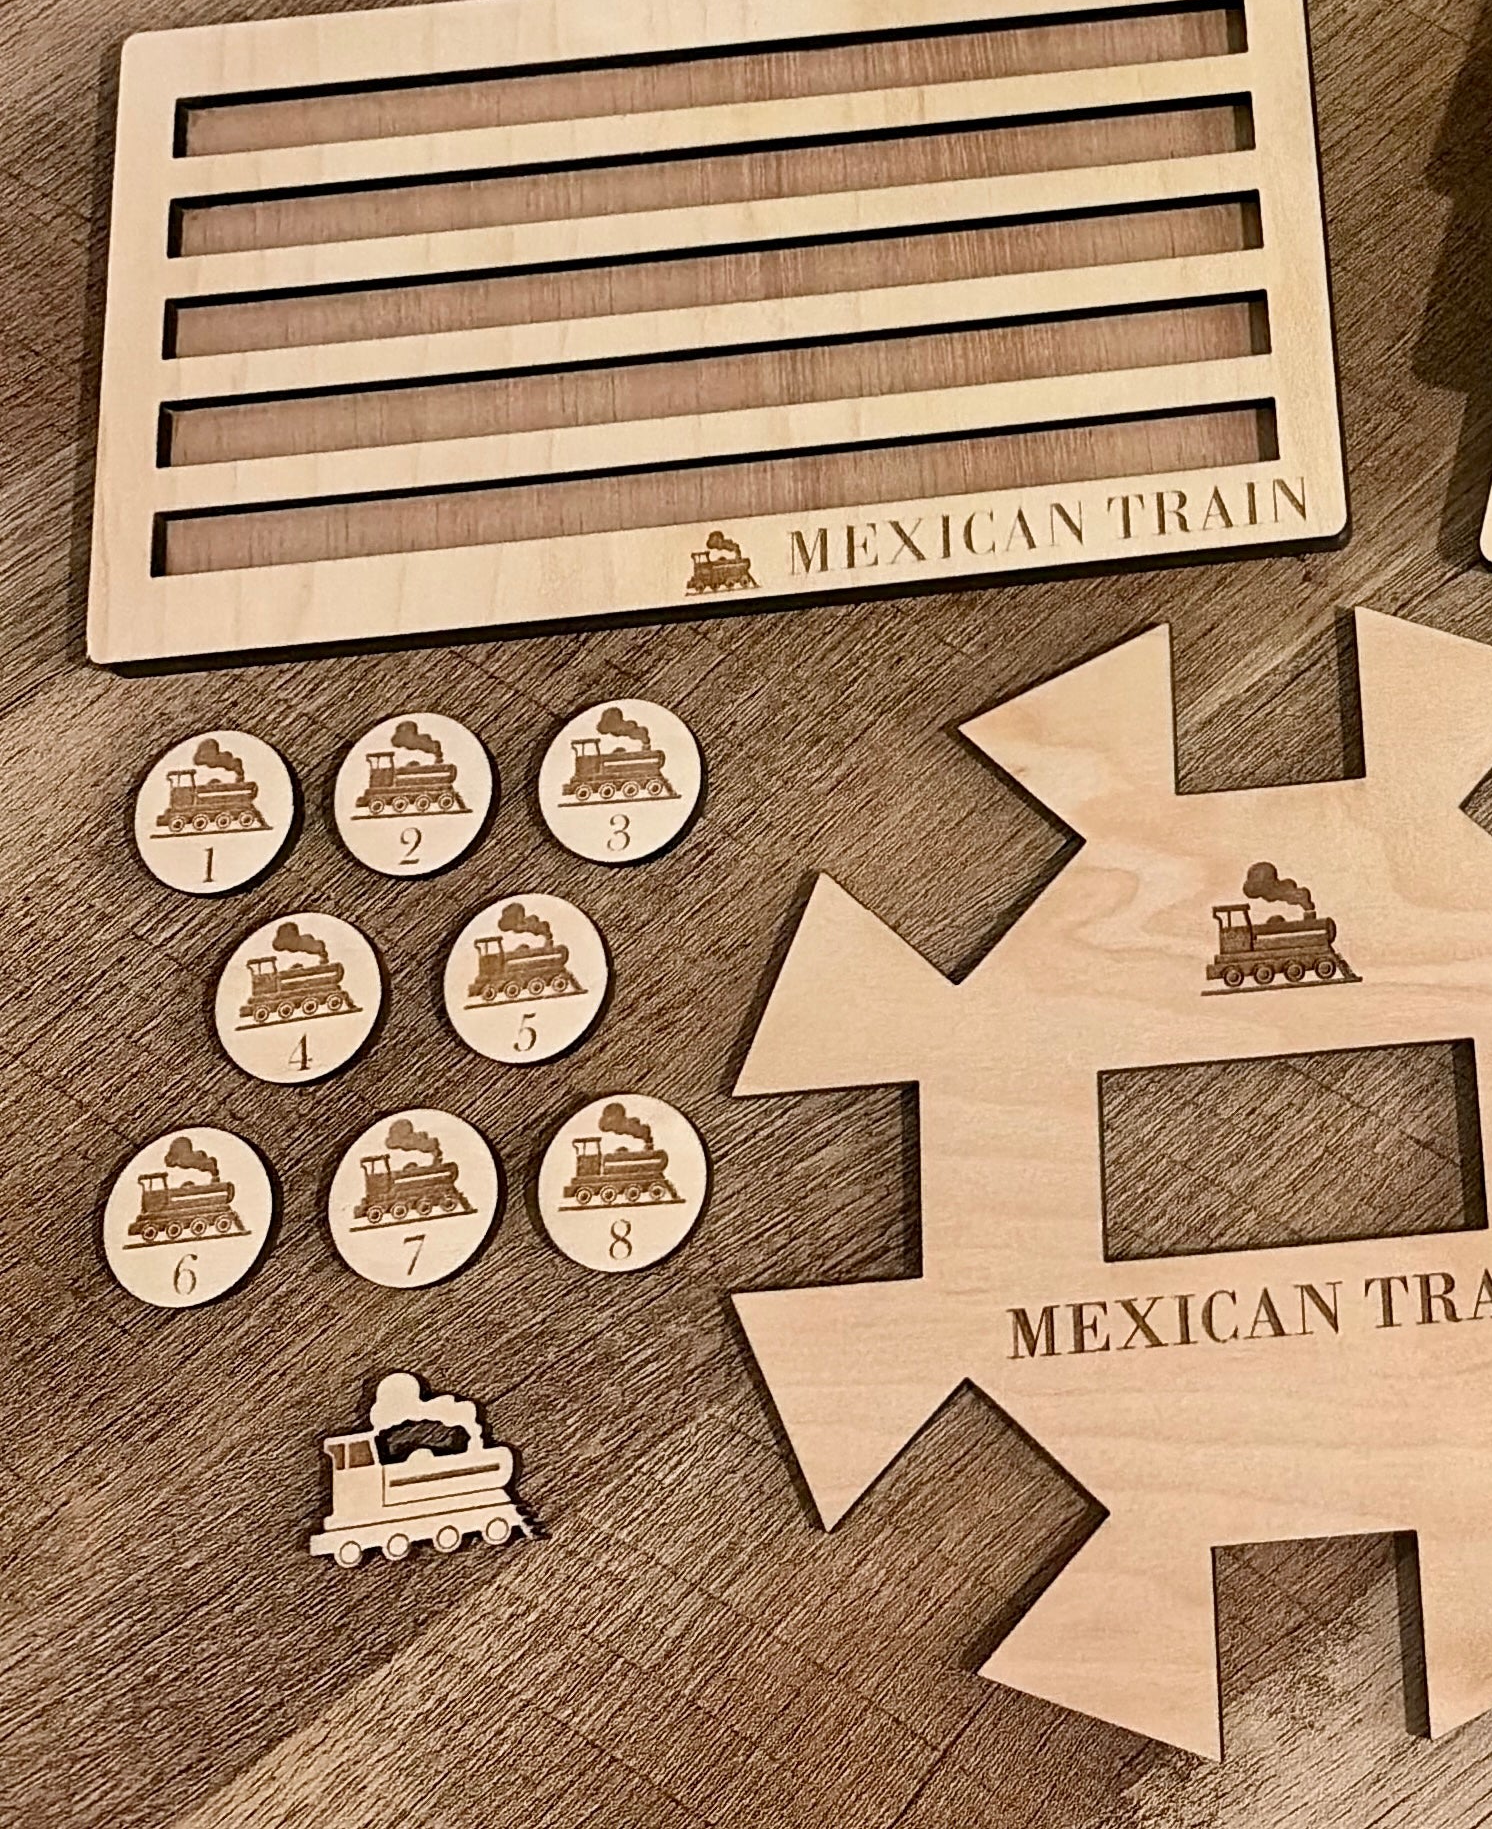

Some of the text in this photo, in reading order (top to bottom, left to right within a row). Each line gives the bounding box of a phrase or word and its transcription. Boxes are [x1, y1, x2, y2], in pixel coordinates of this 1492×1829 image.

[786, 476, 1308, 576] MEXICAN TRAIN
[398, 827, 423, 866] 2
[606, 813, 632, 852] 3
[202, 846, 215, 884] 1
[286, 1033, 314, 1072] 4
[513, 1012, 539, 1053] 5
[402, 1233, 427, 1276] 7
[609, 1218, 633, 1261] 8
[173, 1253, 199, 1296] 6
[1005, 1281, 1343, 1360] MEXICAN
